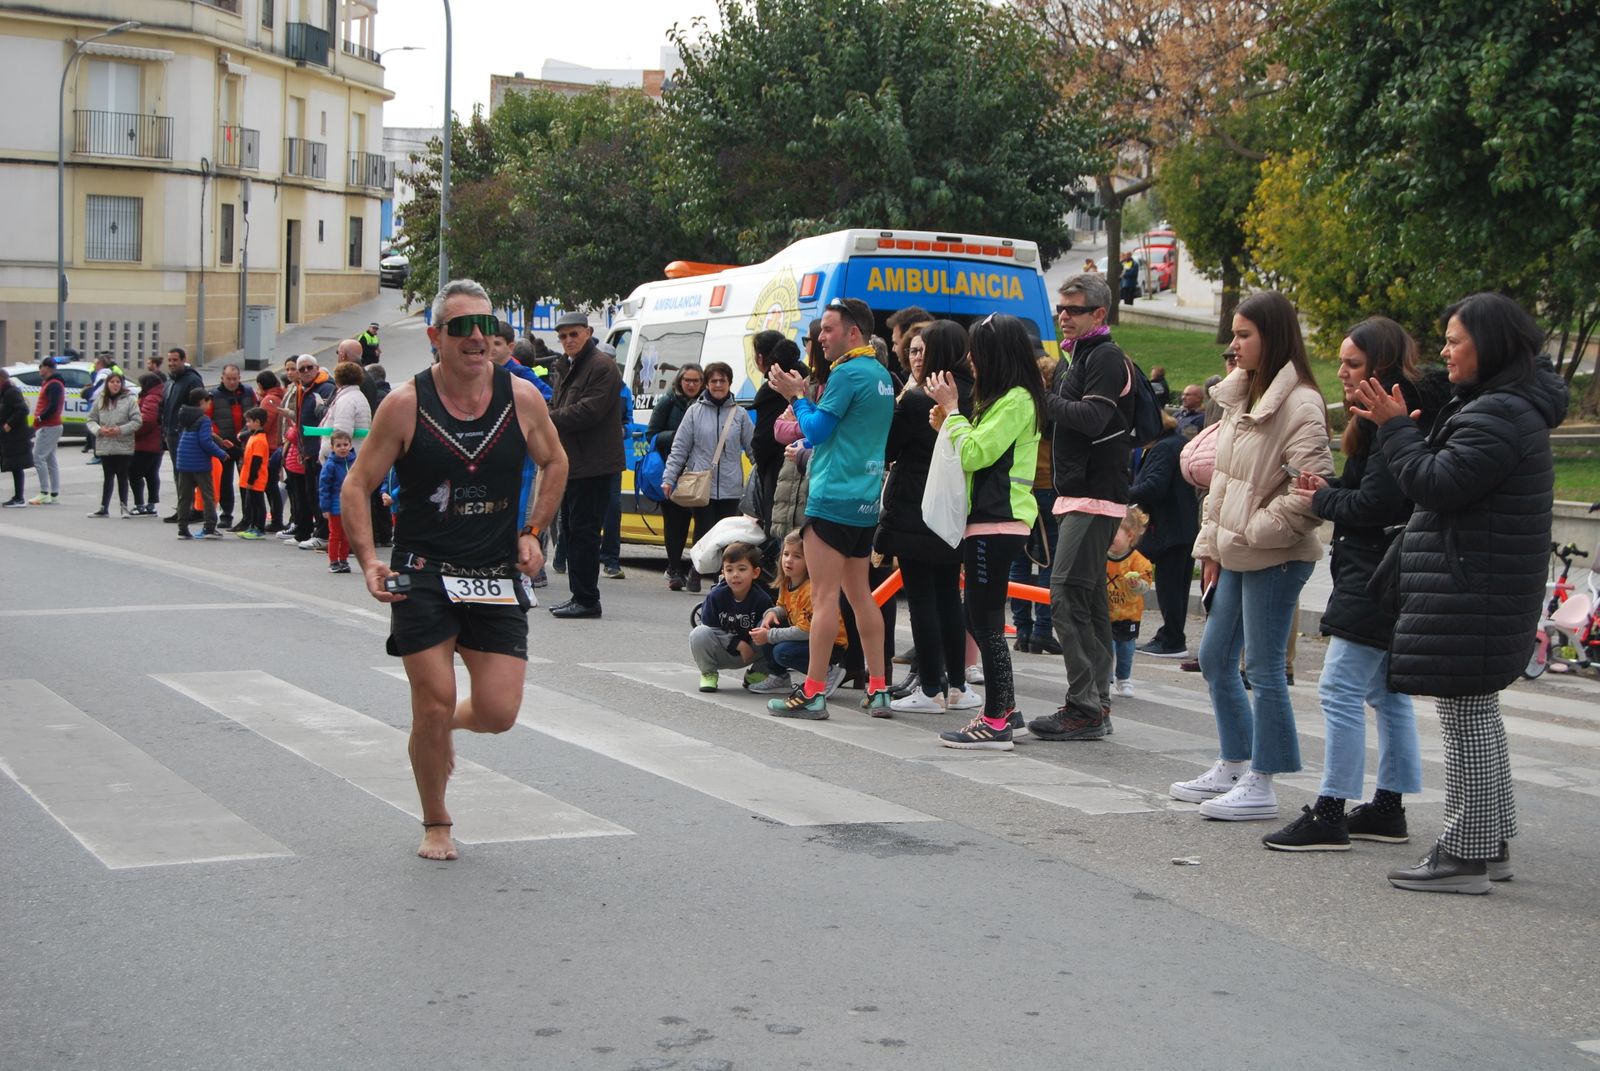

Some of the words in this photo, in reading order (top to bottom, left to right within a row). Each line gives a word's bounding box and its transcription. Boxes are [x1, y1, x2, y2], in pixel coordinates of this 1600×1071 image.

[867, 267, 1024, 300] AMBULANCIA
[635, 394, 651, 409] 627
[454, 485, 488, 501] pies
[976, 539, 988, 584] FASTER
[457, 578, 501, 597] 386
